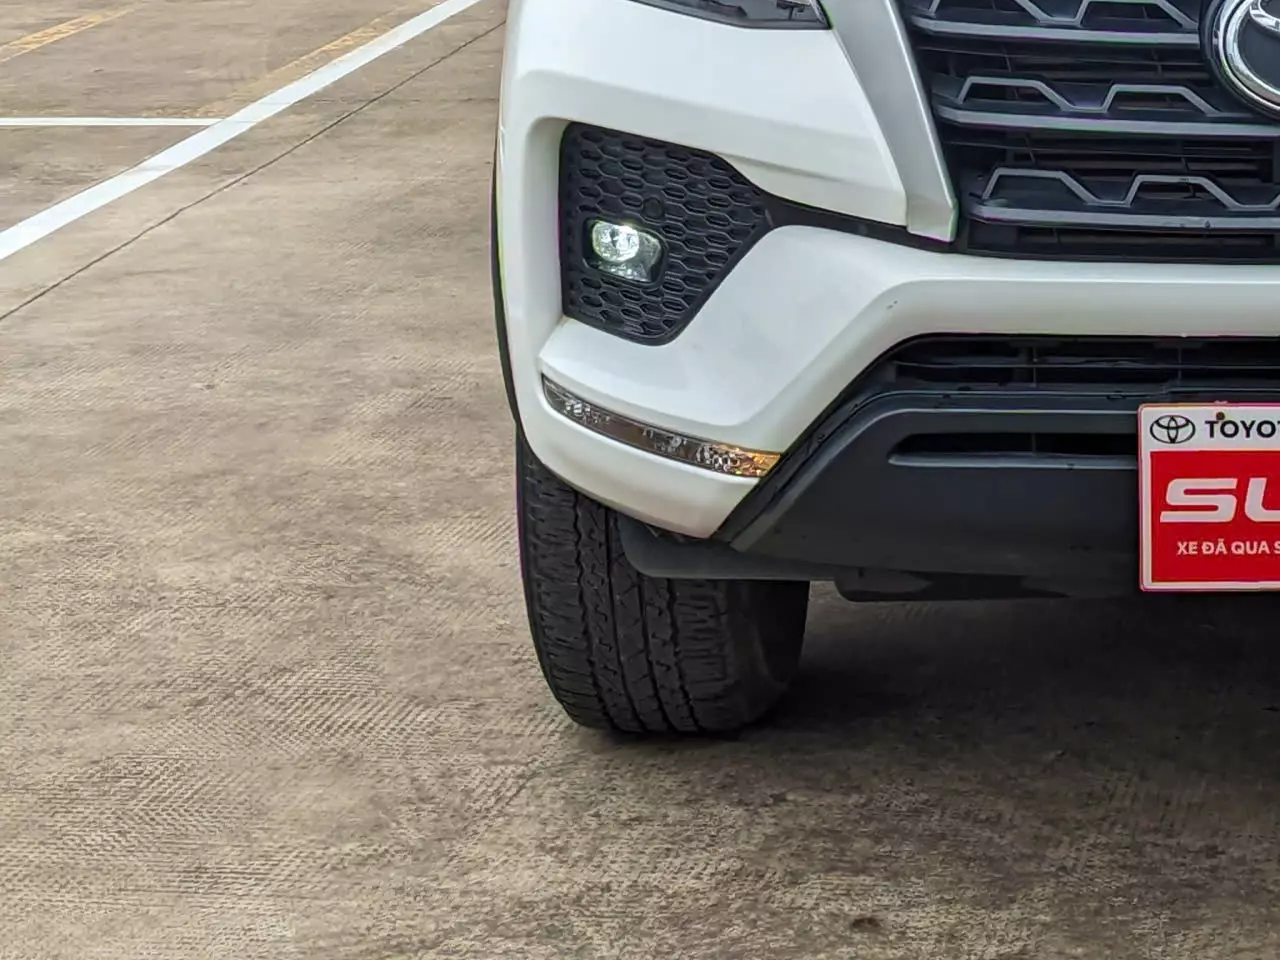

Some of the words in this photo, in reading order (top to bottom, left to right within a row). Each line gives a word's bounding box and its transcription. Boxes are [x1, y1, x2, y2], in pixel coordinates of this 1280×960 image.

[1177, 541, 1198, 556] XE
[1201, 538, 1227, 555] ĐÃ
[1231, 541, 1270, 555] QUA
